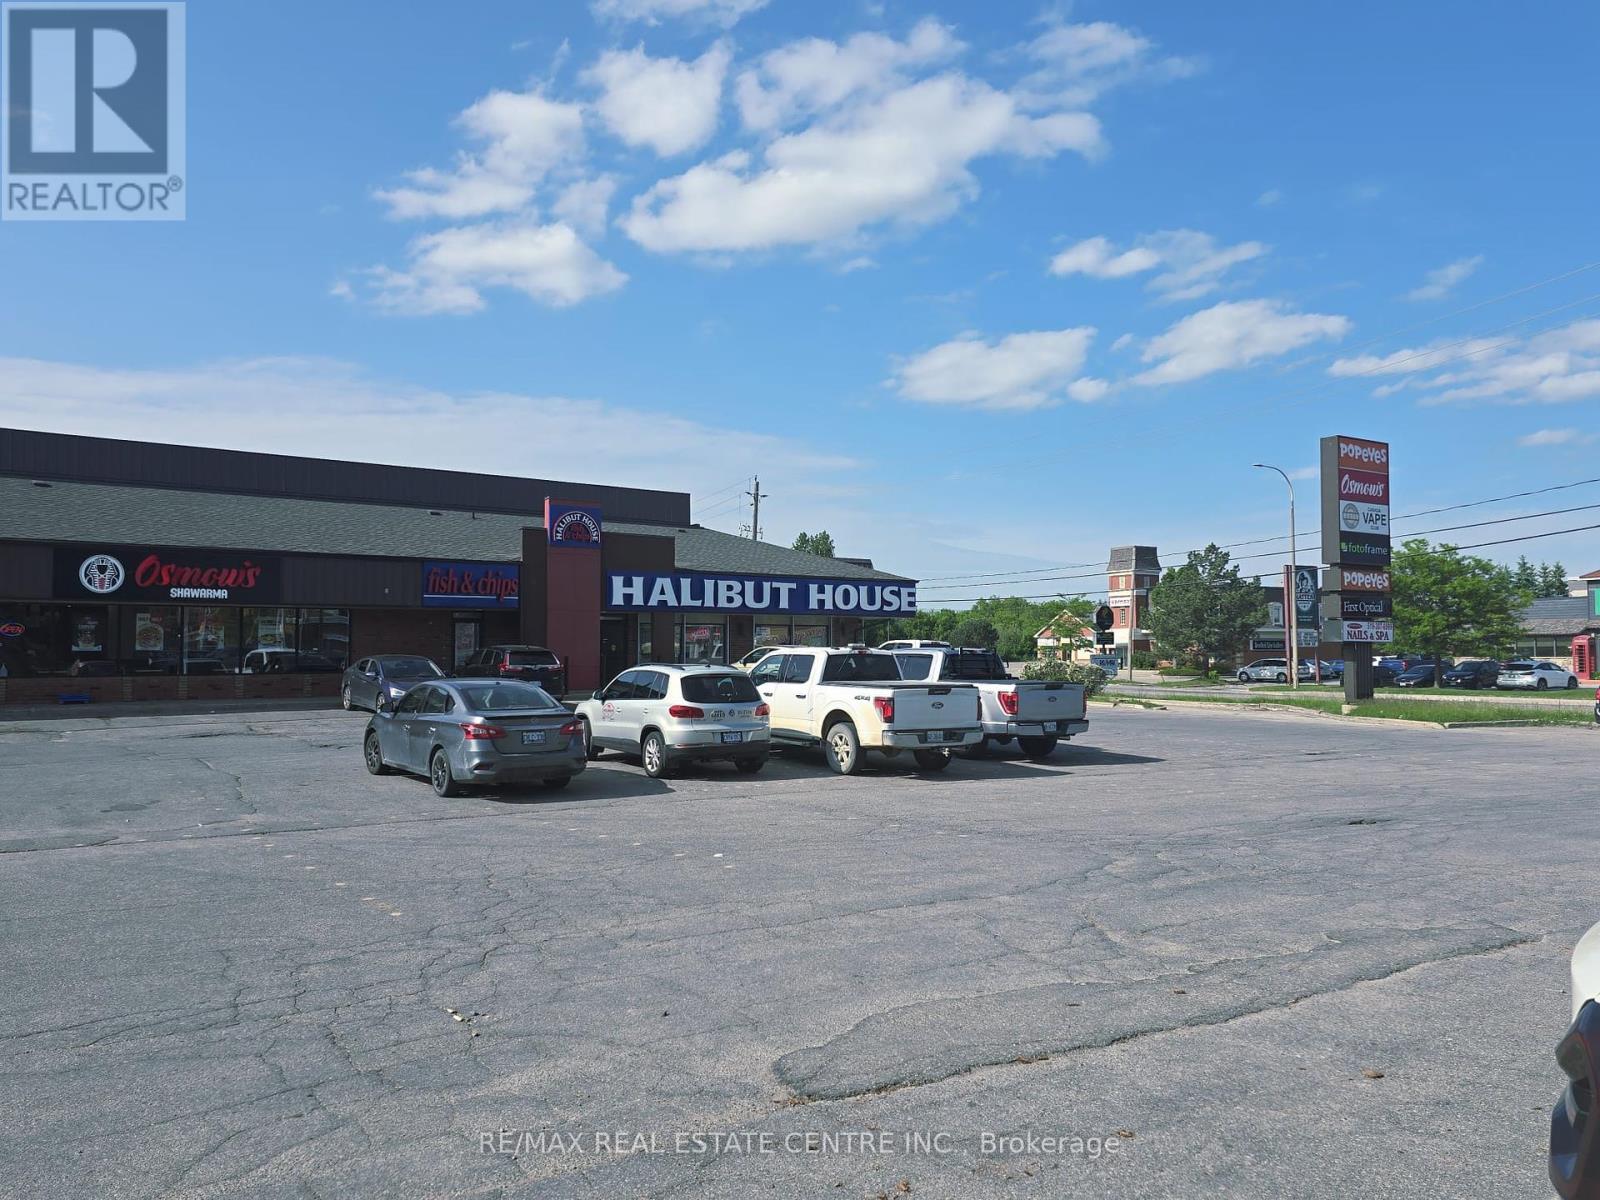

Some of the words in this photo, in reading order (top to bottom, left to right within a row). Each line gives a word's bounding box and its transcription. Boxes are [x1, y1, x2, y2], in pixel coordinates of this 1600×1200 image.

[1362, 511, 1387, 526] VAPE
[555, 513, 582, 541] HALIBUT
[582, 515, 599, 543] HOUSE
[1348, 542, 1388, 556] fotoframe
[427, 567, 458, 594] fish
[460, 570, 475, 594] &
[478, 569, 519, 602] chips
[169, 587, 228, 599] SHAWARMA
[611, 575, 797, 610] HALIBUT
[808, 583, 917, 612] HOUSE
[1344, 601, 1358, 612] First
[1360, 601, 1383, 616] Optical
[1346, 630, 1368, 641] NAILS
[1369, 632, 1375, 641] &
[1375, 630, 1389, 641] SPA
